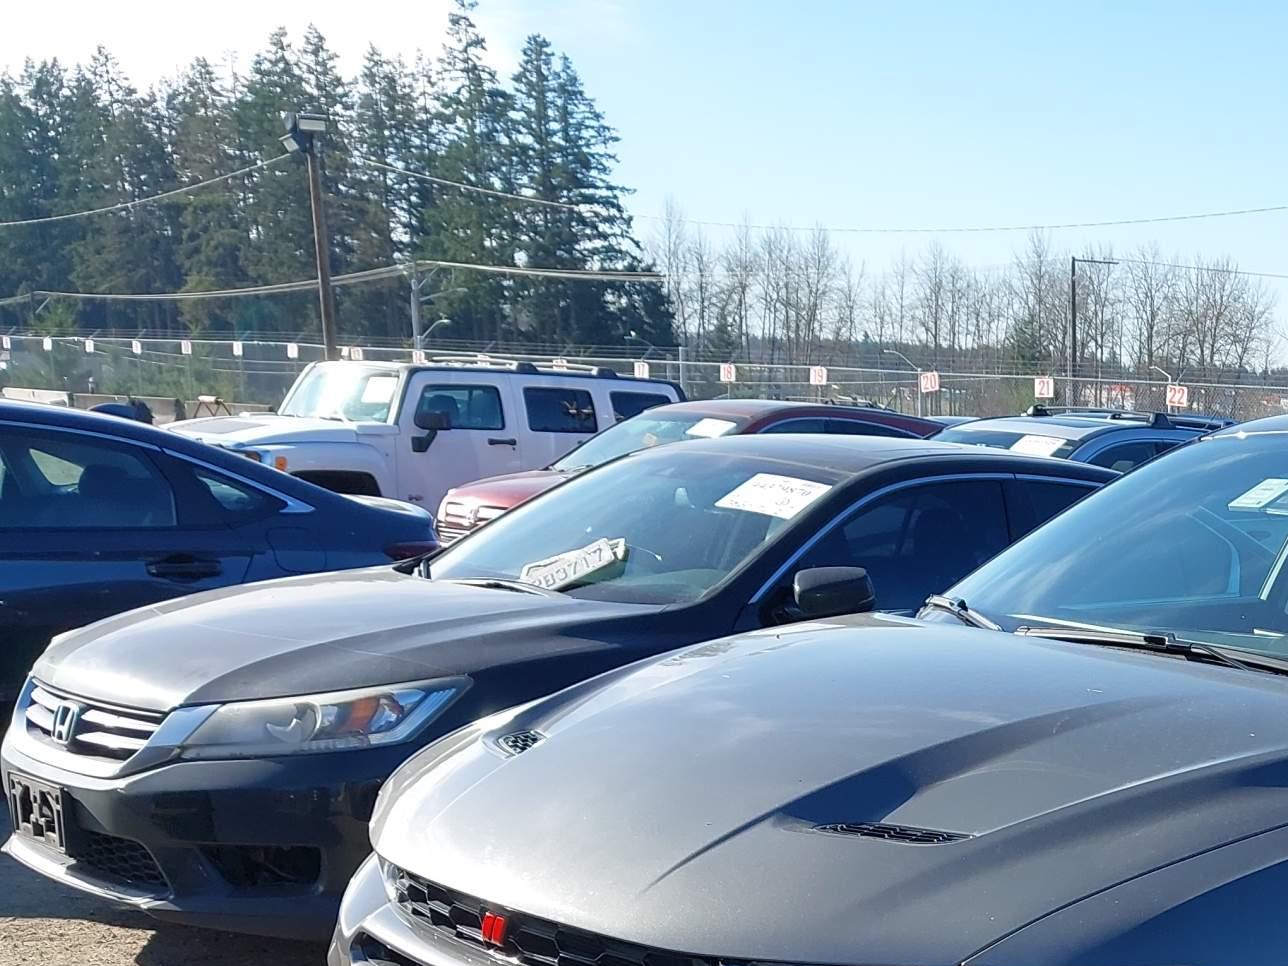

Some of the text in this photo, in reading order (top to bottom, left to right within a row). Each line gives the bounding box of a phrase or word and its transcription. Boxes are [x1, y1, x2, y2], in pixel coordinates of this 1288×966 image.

[723, 364, 734, 380] 18
[813, 369, 824, 383] 19
[922, 374, 938, 390] 20
[1038, 380, 1050, 395] 21
[1168, 387, 1186, 404] 22
